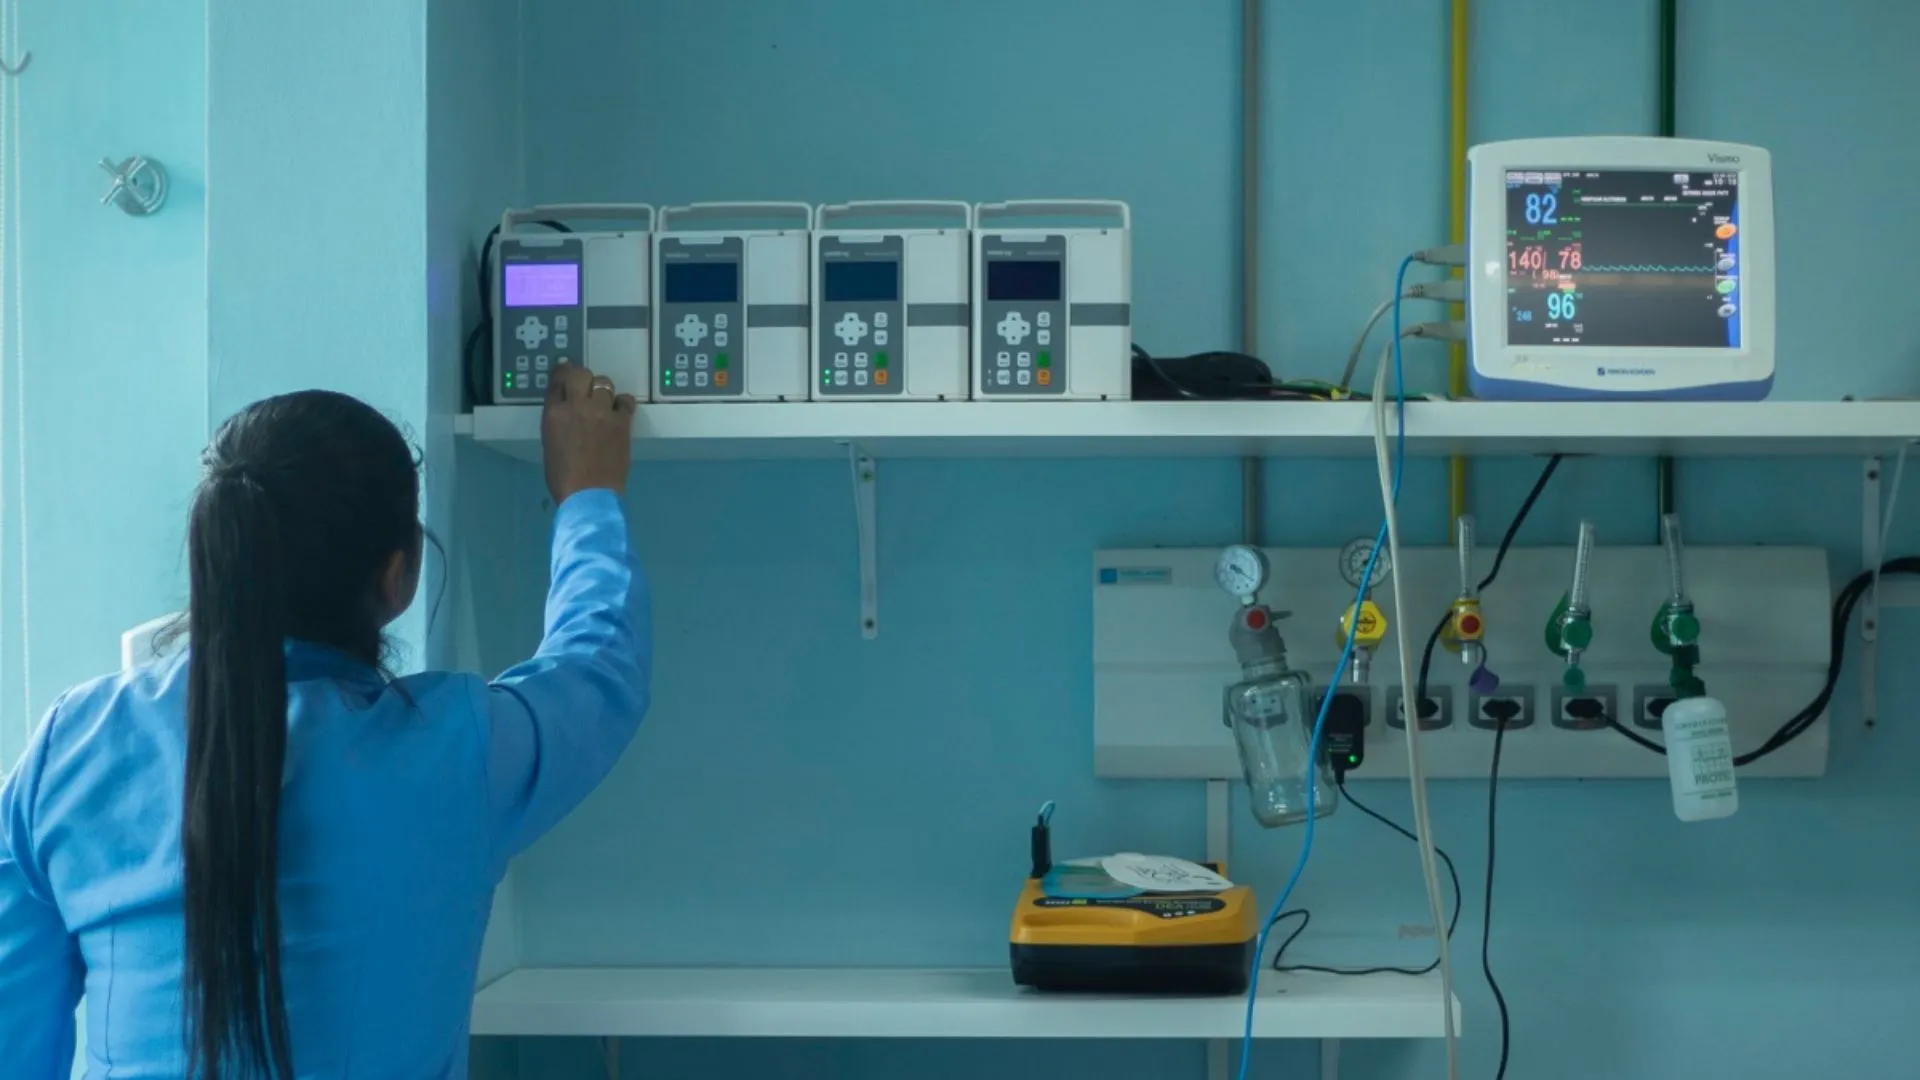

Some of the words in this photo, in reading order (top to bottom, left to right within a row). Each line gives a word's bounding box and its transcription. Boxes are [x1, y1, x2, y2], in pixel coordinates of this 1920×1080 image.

[1525, 193, 1557, 224] 82
[1558, 250, 1582, 270] 78
[1547, 292, 1576, 320] 96
